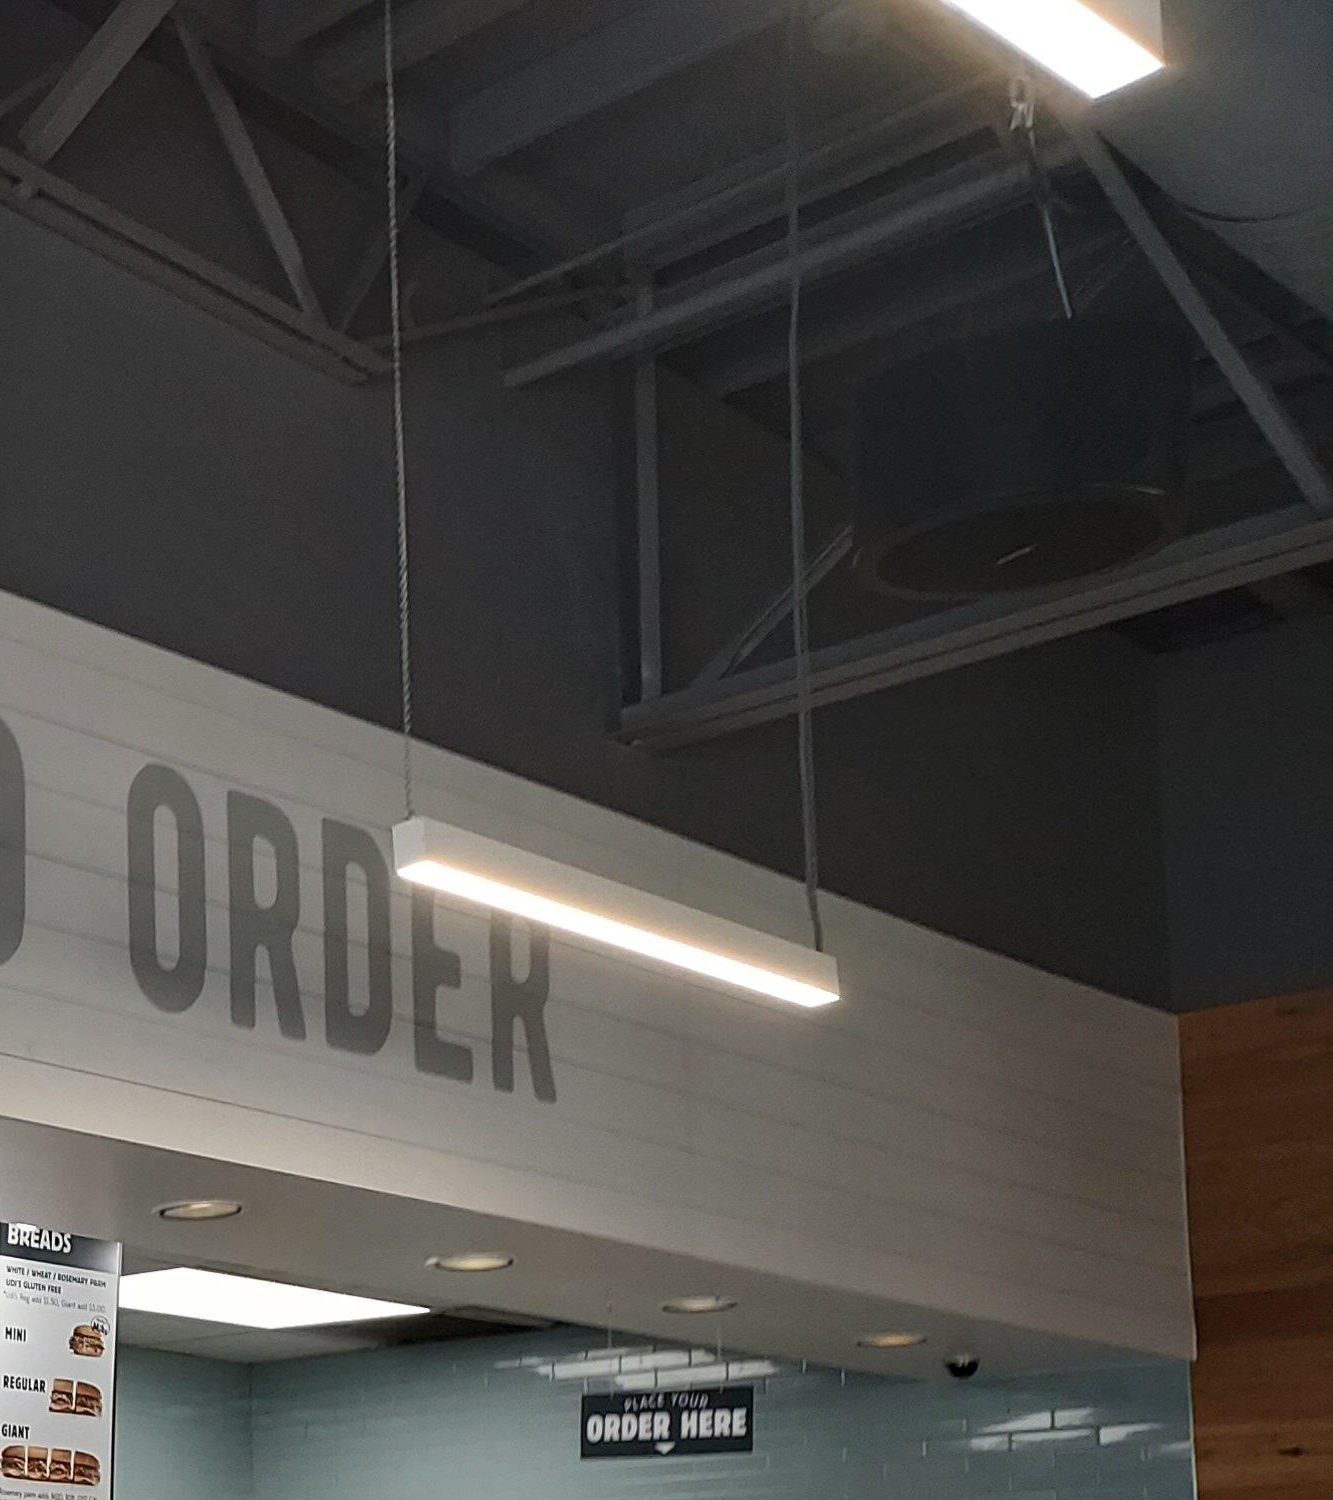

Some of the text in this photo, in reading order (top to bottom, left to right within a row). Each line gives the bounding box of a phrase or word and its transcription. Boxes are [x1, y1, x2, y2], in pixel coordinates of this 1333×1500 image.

[126, 762, 560, 1106] ORDER
[8, 1223, 71, 1253] BREADS
[5, 1327, 27, 1342] MINI
[3, 1376, 46, 1393] REGULAR
[624, 1391, 708, 1413] PLACE YOUR
[1, 1424, 30, 1439] GIANT
[587, 1407, 747, 1443] ORDER HERE
